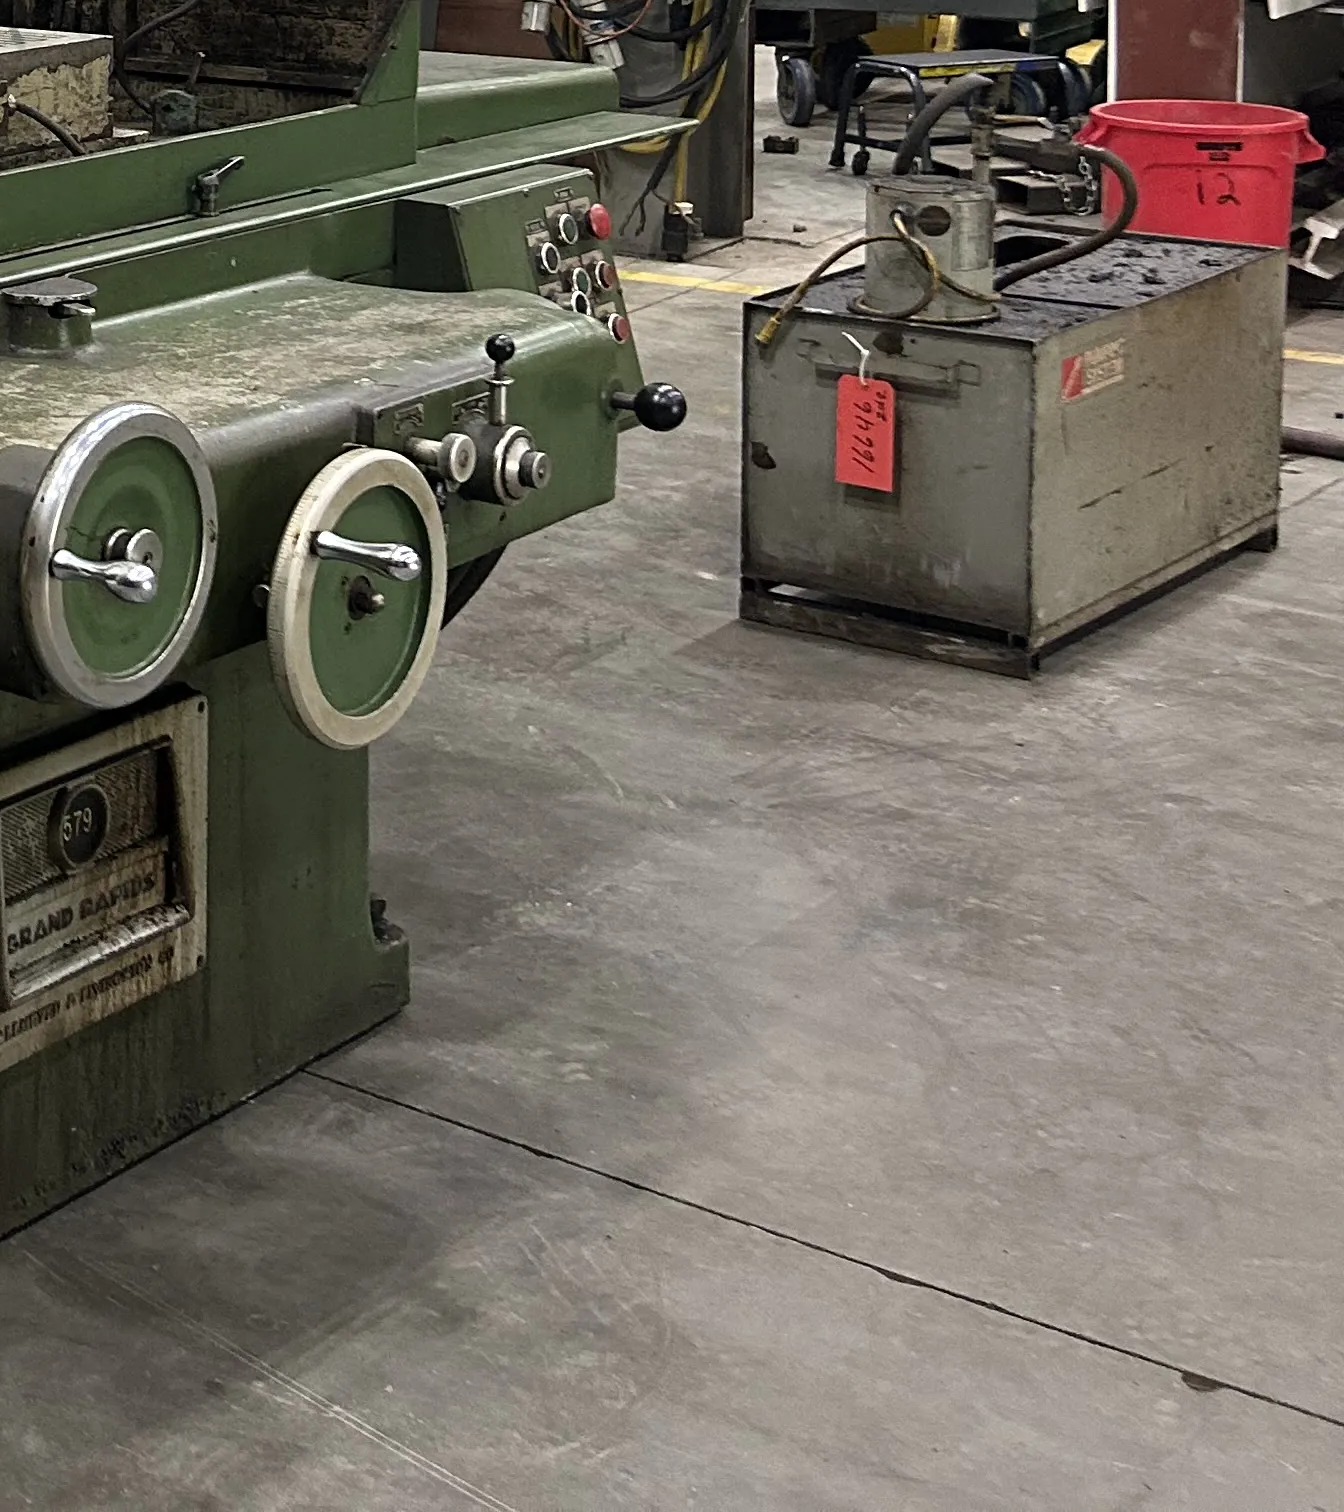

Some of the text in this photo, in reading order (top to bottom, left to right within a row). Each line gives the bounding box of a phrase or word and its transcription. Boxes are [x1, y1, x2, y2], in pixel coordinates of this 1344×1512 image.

[1195, 169, 1242, 206] 12
[851, 400, 876, 475] 16646
[7, 875, 156, 954] GRAND RAPIDS
